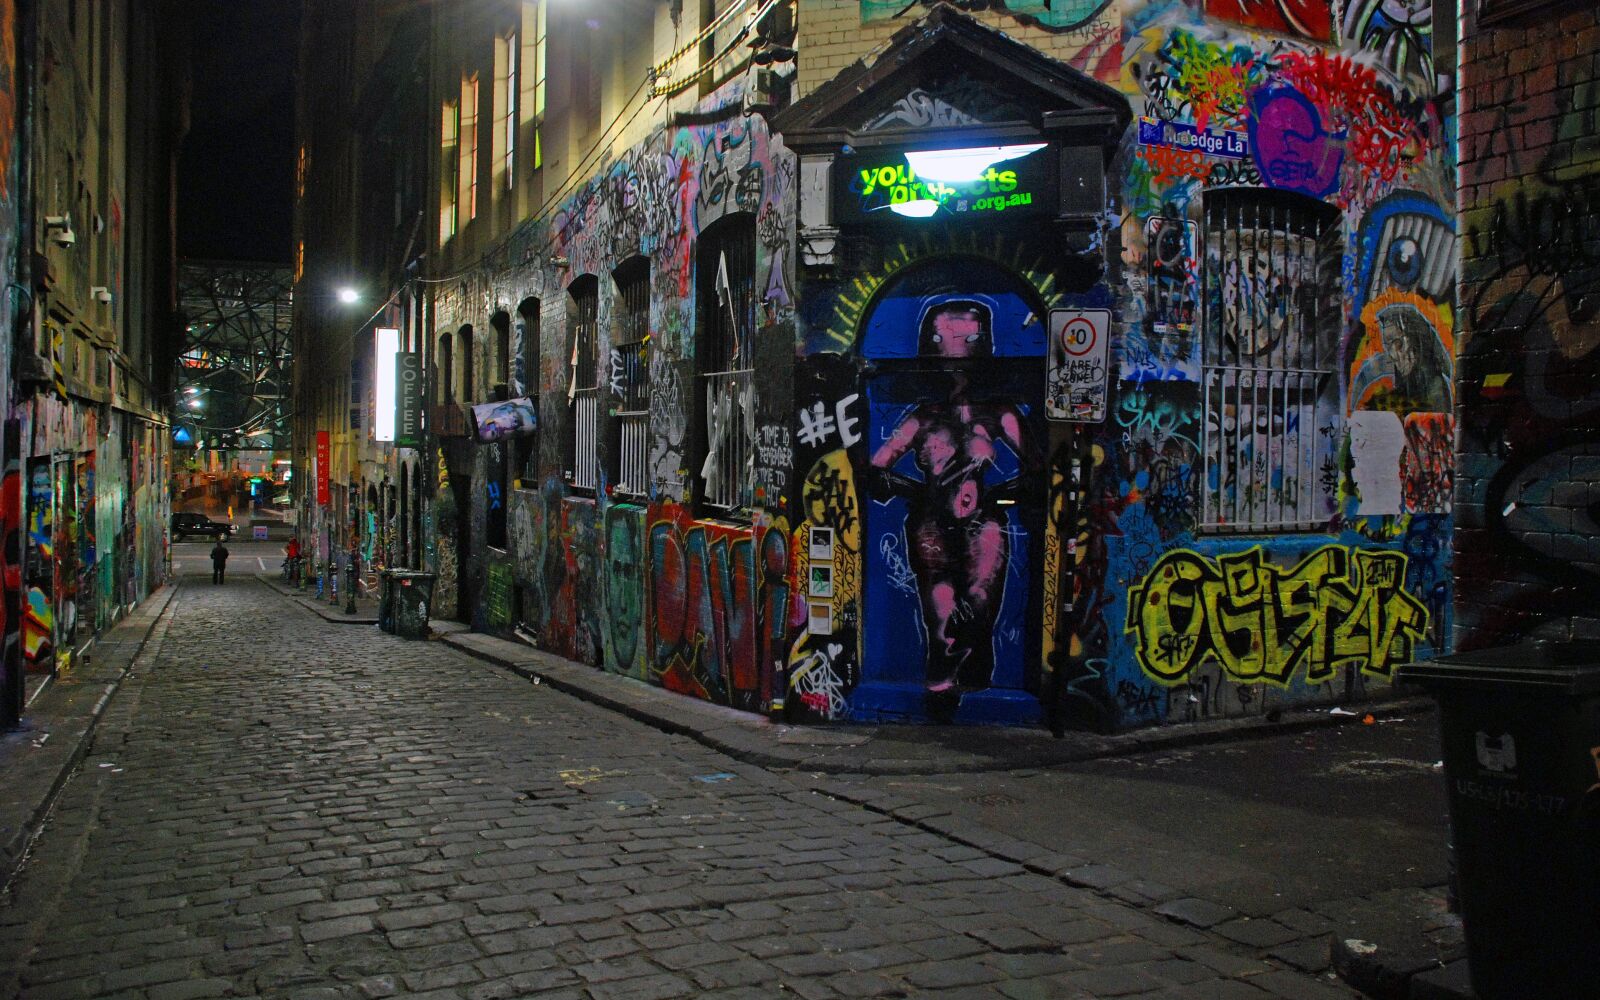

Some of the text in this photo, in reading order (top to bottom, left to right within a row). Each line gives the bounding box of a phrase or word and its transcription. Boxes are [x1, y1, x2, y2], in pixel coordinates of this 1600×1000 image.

[1227, 135, 1243, 153] La
[972, 192, 1032, 212] .org.au
[401, 355, 416, 435] COFFEE
[317, 444, 325, 490] MOVIDA
